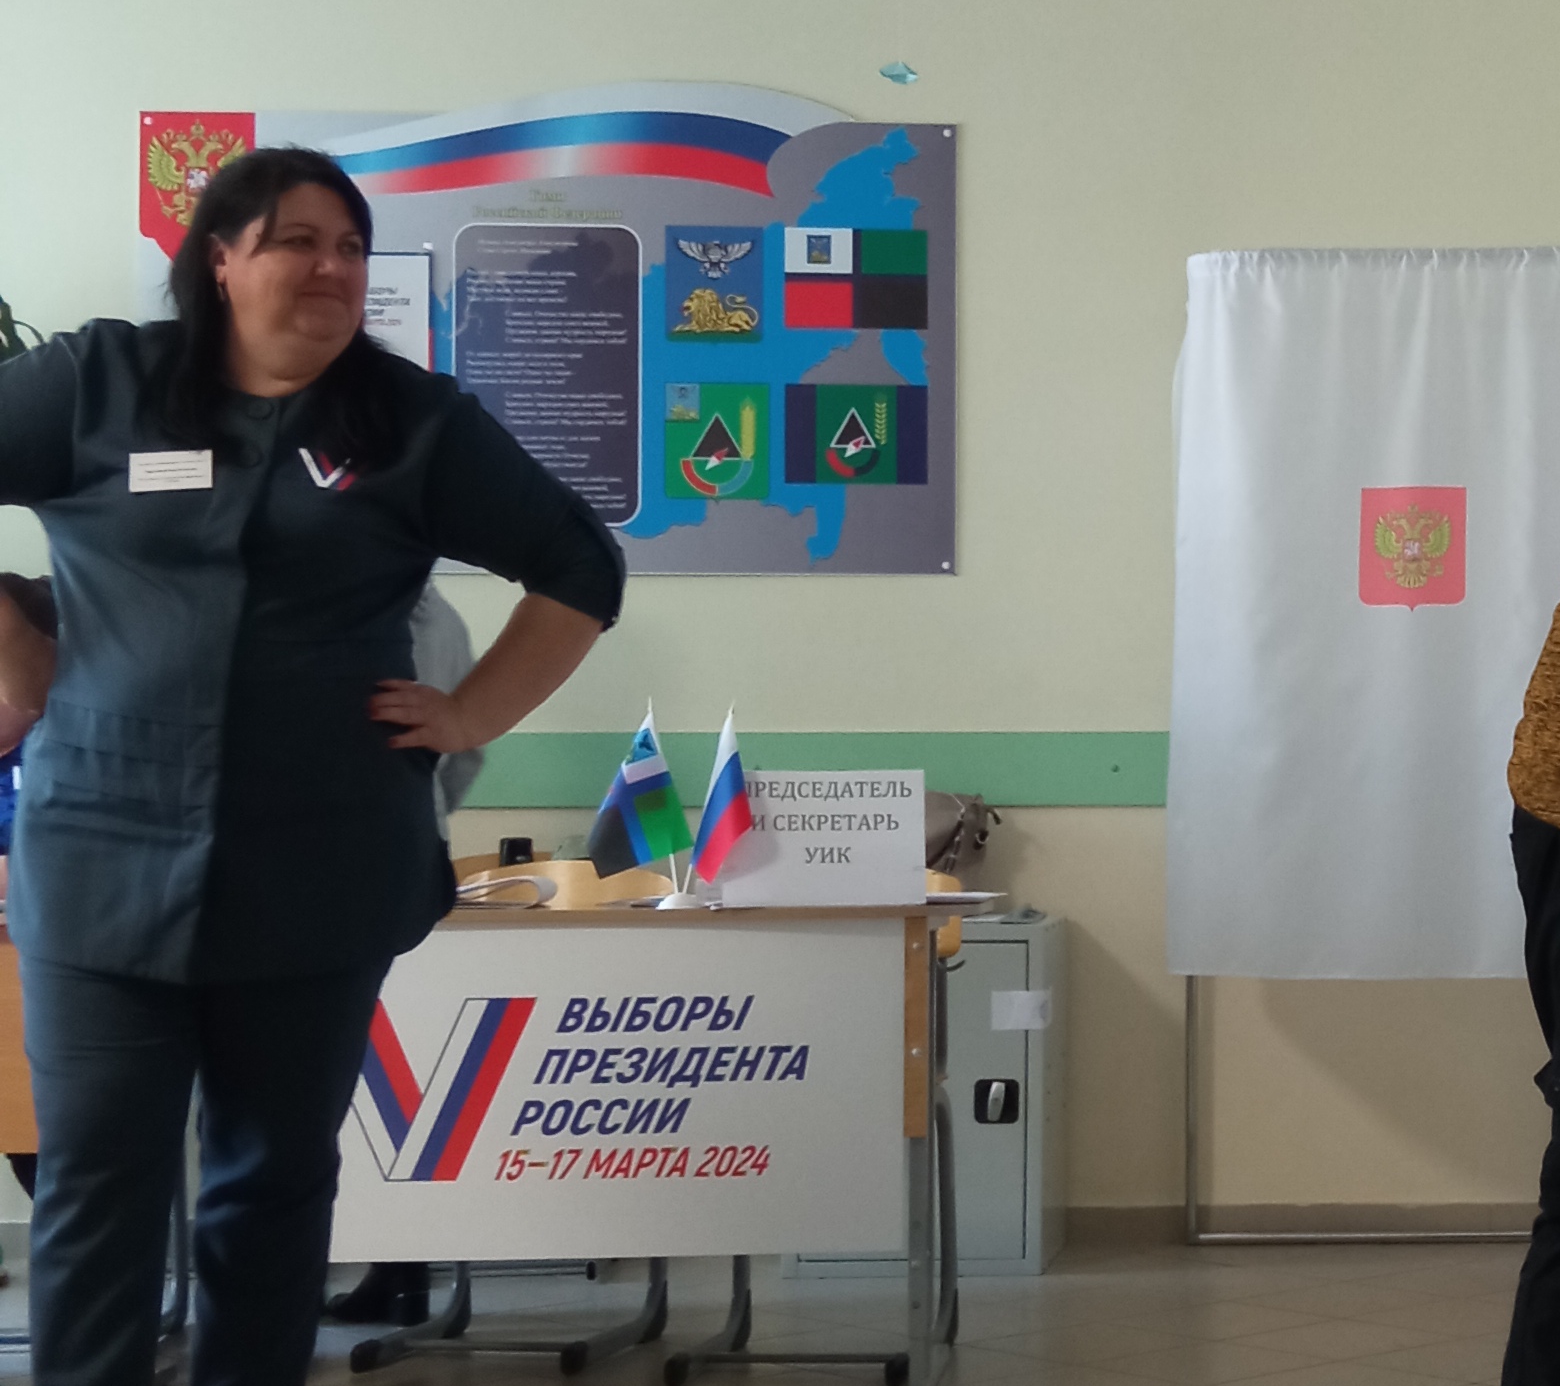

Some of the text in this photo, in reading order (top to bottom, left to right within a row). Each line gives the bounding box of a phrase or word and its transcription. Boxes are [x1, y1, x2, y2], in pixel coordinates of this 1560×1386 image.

[752, 814, 900, 831] И СЕКРЕТАРЬ
[805, 847, 852, 864] УИК
[556, 994, 755, 1034] ВЫБОРЫ
[533, 1044, 810, 1088] ПРЕЗИДЕНТА
[510, 1097, 692, 1136] РОССИИ
[583, 1145, 691, 1180] МАРТА
[694, 1144, 771, 1178] 2024
